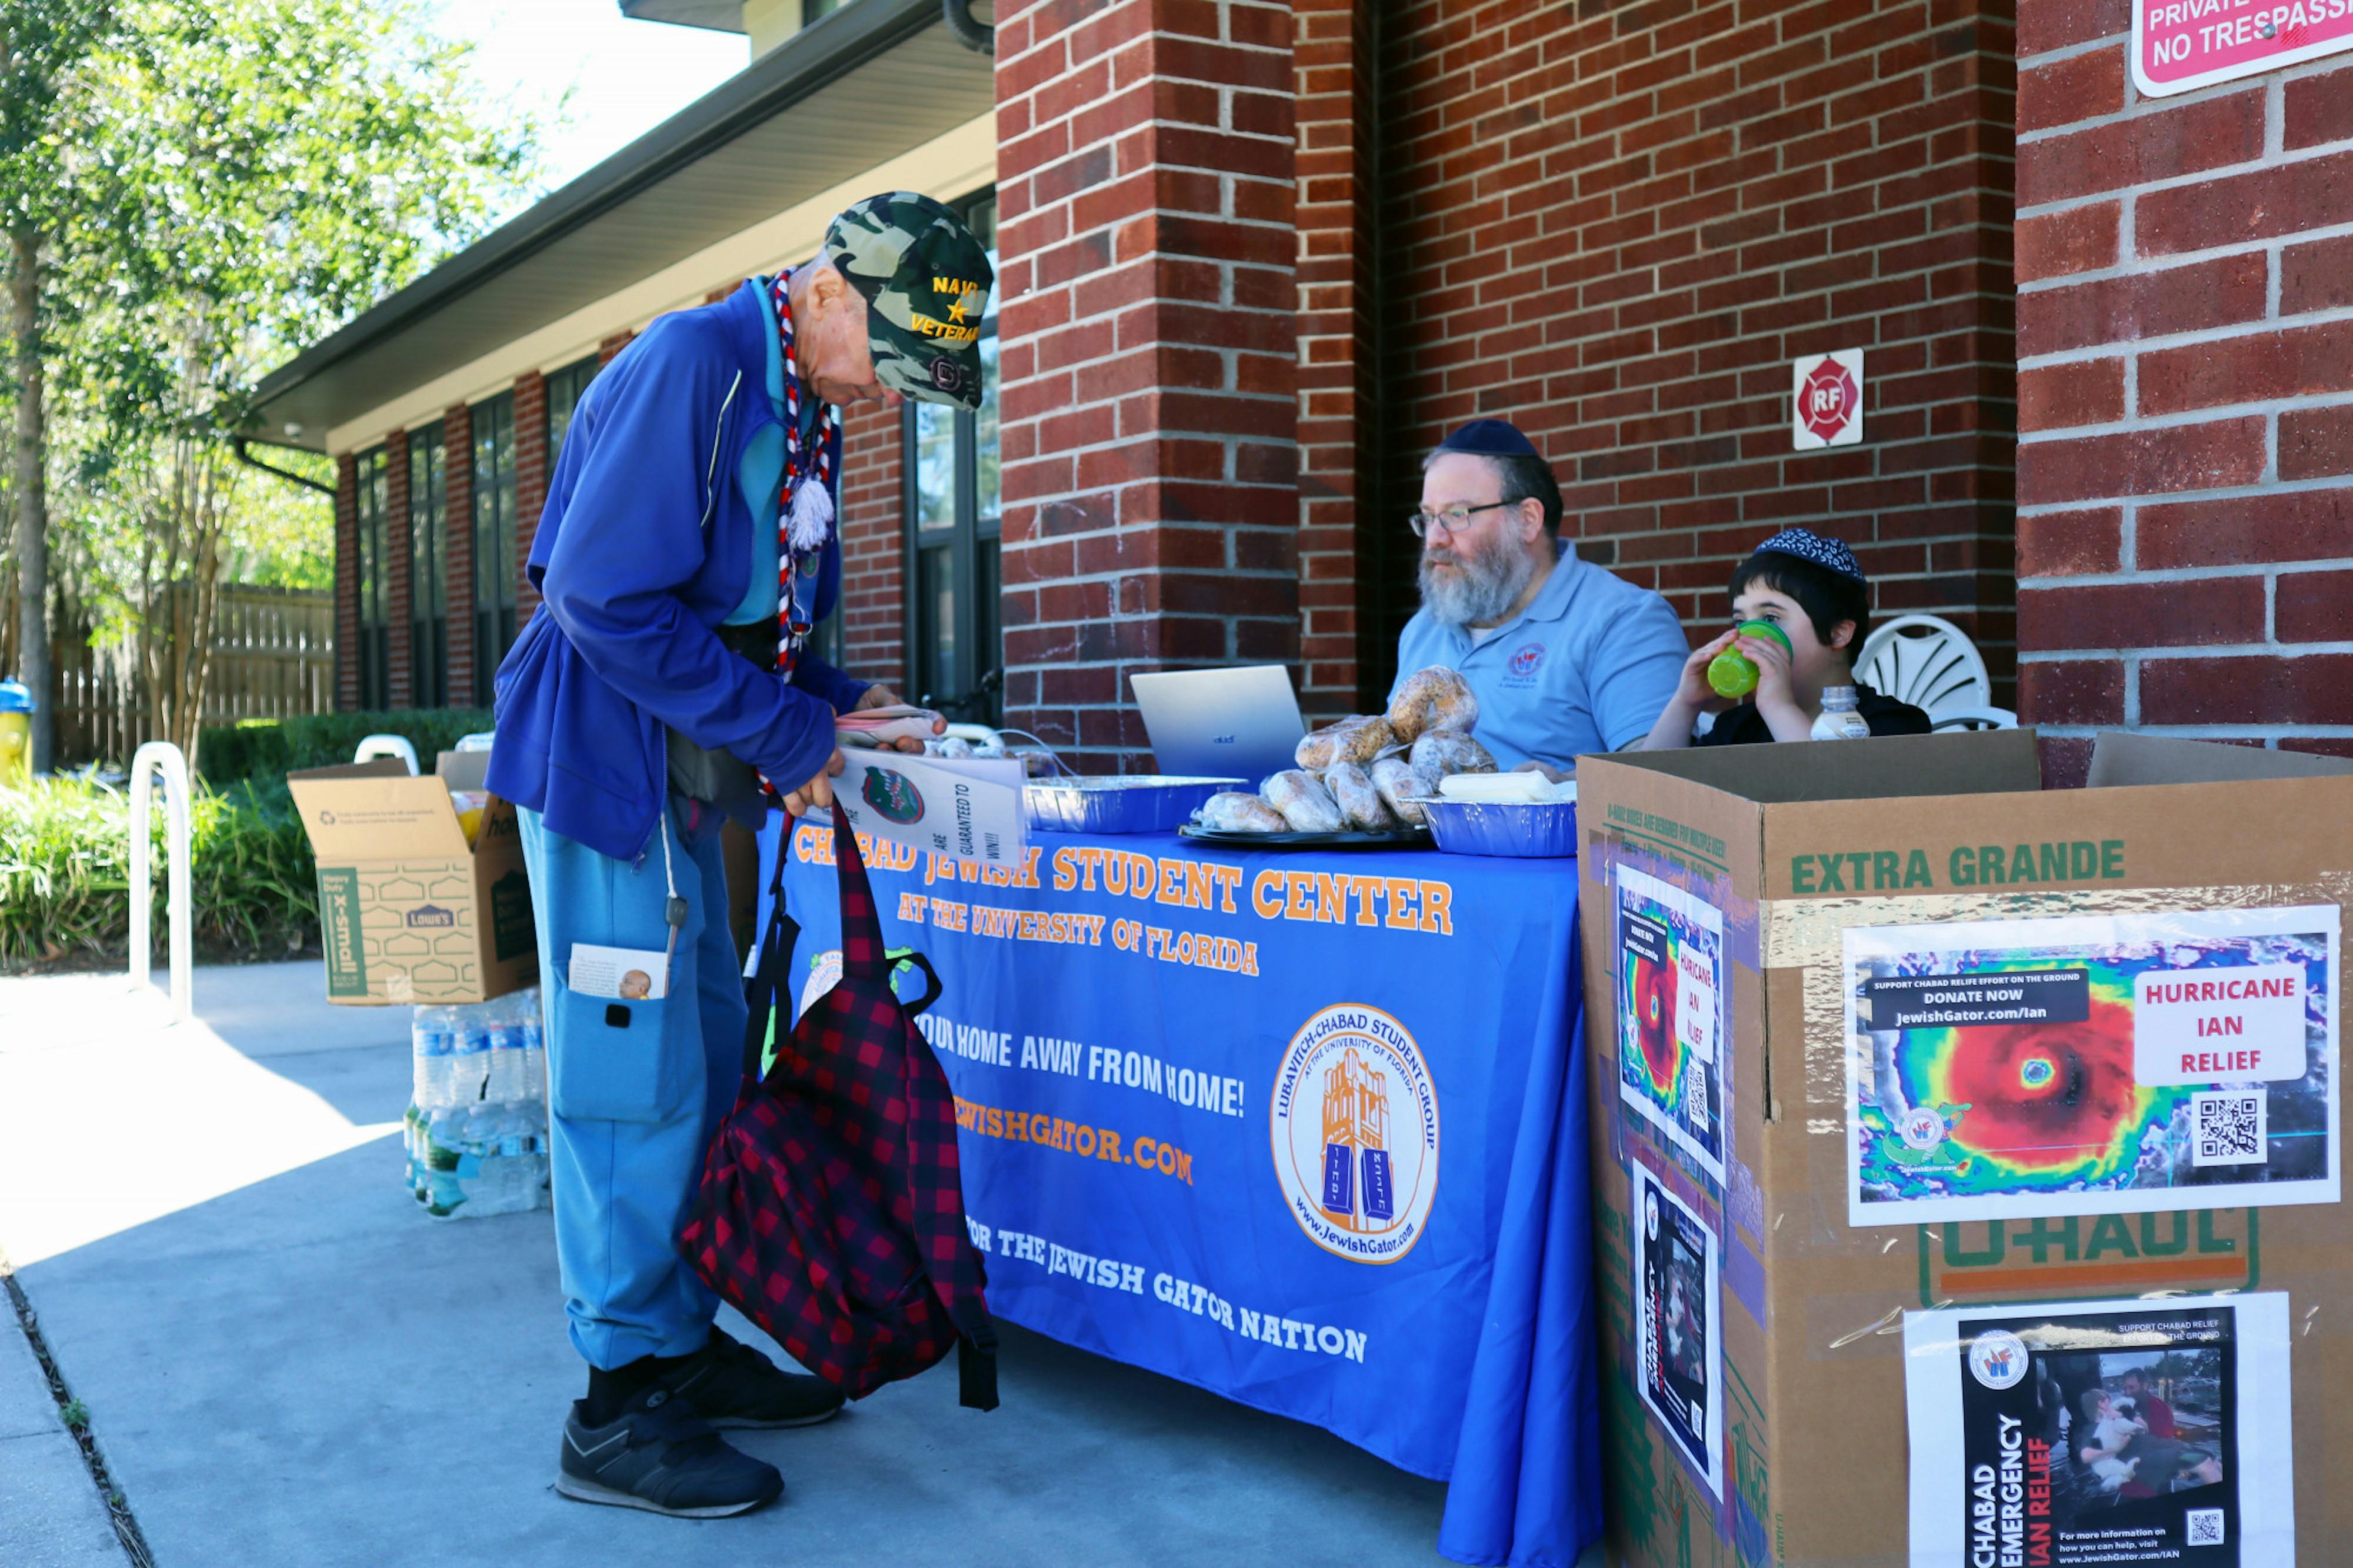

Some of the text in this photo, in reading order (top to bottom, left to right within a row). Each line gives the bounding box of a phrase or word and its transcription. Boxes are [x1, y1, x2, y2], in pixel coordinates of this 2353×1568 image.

[2154, 34, 2191, 66] NO
[1814, 387, 1841, 413] RF
[955, 783, 974, 856] GUARANTEED TO
[933, 833, 948, 851] ARE
[984, 832, 1000, 859] WIN!!!
[794, 825, 918, 872] CHBAD
[1052, 847, 1242, 914] STUDENT
[1252, 869, 1454, 935] CENTER
[1791, 840, 2125, 894] EXTRA GRANDE
[897, 892, 1260, 977] AT THE UNIVERSITY OF FLORIDA
[1874, 982, 1912, 990] SUPPORT
[1914, 979, 1949, 987] CHABAD
[1979, 977, 2009, 985] EFFORT
[2025, 975, 2041, 983] THE
[2043, 973, 2080, 982] GROUND
[1924, 989, 2023, 1004] DONATE NOW
[2147, 978, 2295, 1005] HURRICANE
[1896, 1007, 2047, 1027] JewishGator.com/Ian
[2198, 1016, 2243, 1037] IAN
[913, 1013, 1245, 1119] OUR HOME AWAY FROM HOME!
[1324, 1037, 1372, 1053] UNIVERSITY
[1373, 1045, 1386, 1057] OF
[1387, 1053, 1413, 1097] FLORIDA
[2181, 1050, 2261, 1073] RELIEF
[1278, 1013, 1435, 1150] LUBAVITCH-CHABAD STUDENT GROUP
[953, 1095, 1194, 1186] EWISHGATOR.COM
[1297, 1196, 1414, 1254] www.JewishGator.com
[998, 1229, 1046, 1266] THE
[1048, 1242, 1145, 1295] JEWISH
[1153, 1272, 1234, 1332] GATOR
[1240, 1306, 1368, 1364] NATION
[2119, 1319, 2219, 1332] SUPPORT CHABAD RELIEF
[2169, 1332, 2184, 1340] THE
[2187, 1331, 2220, 1340] GROUND
[1999, 1413, 2024, 1567] EMERGENCY
[2028, 1439, 2051, 1566] IAN RELIEF
[1974, 1464, 1996, 1568] CHABAD
[2101, 1529, 2154, 1538] information
[2059, 1550, 2179, 1564] www.JewishGator.com/IAN
